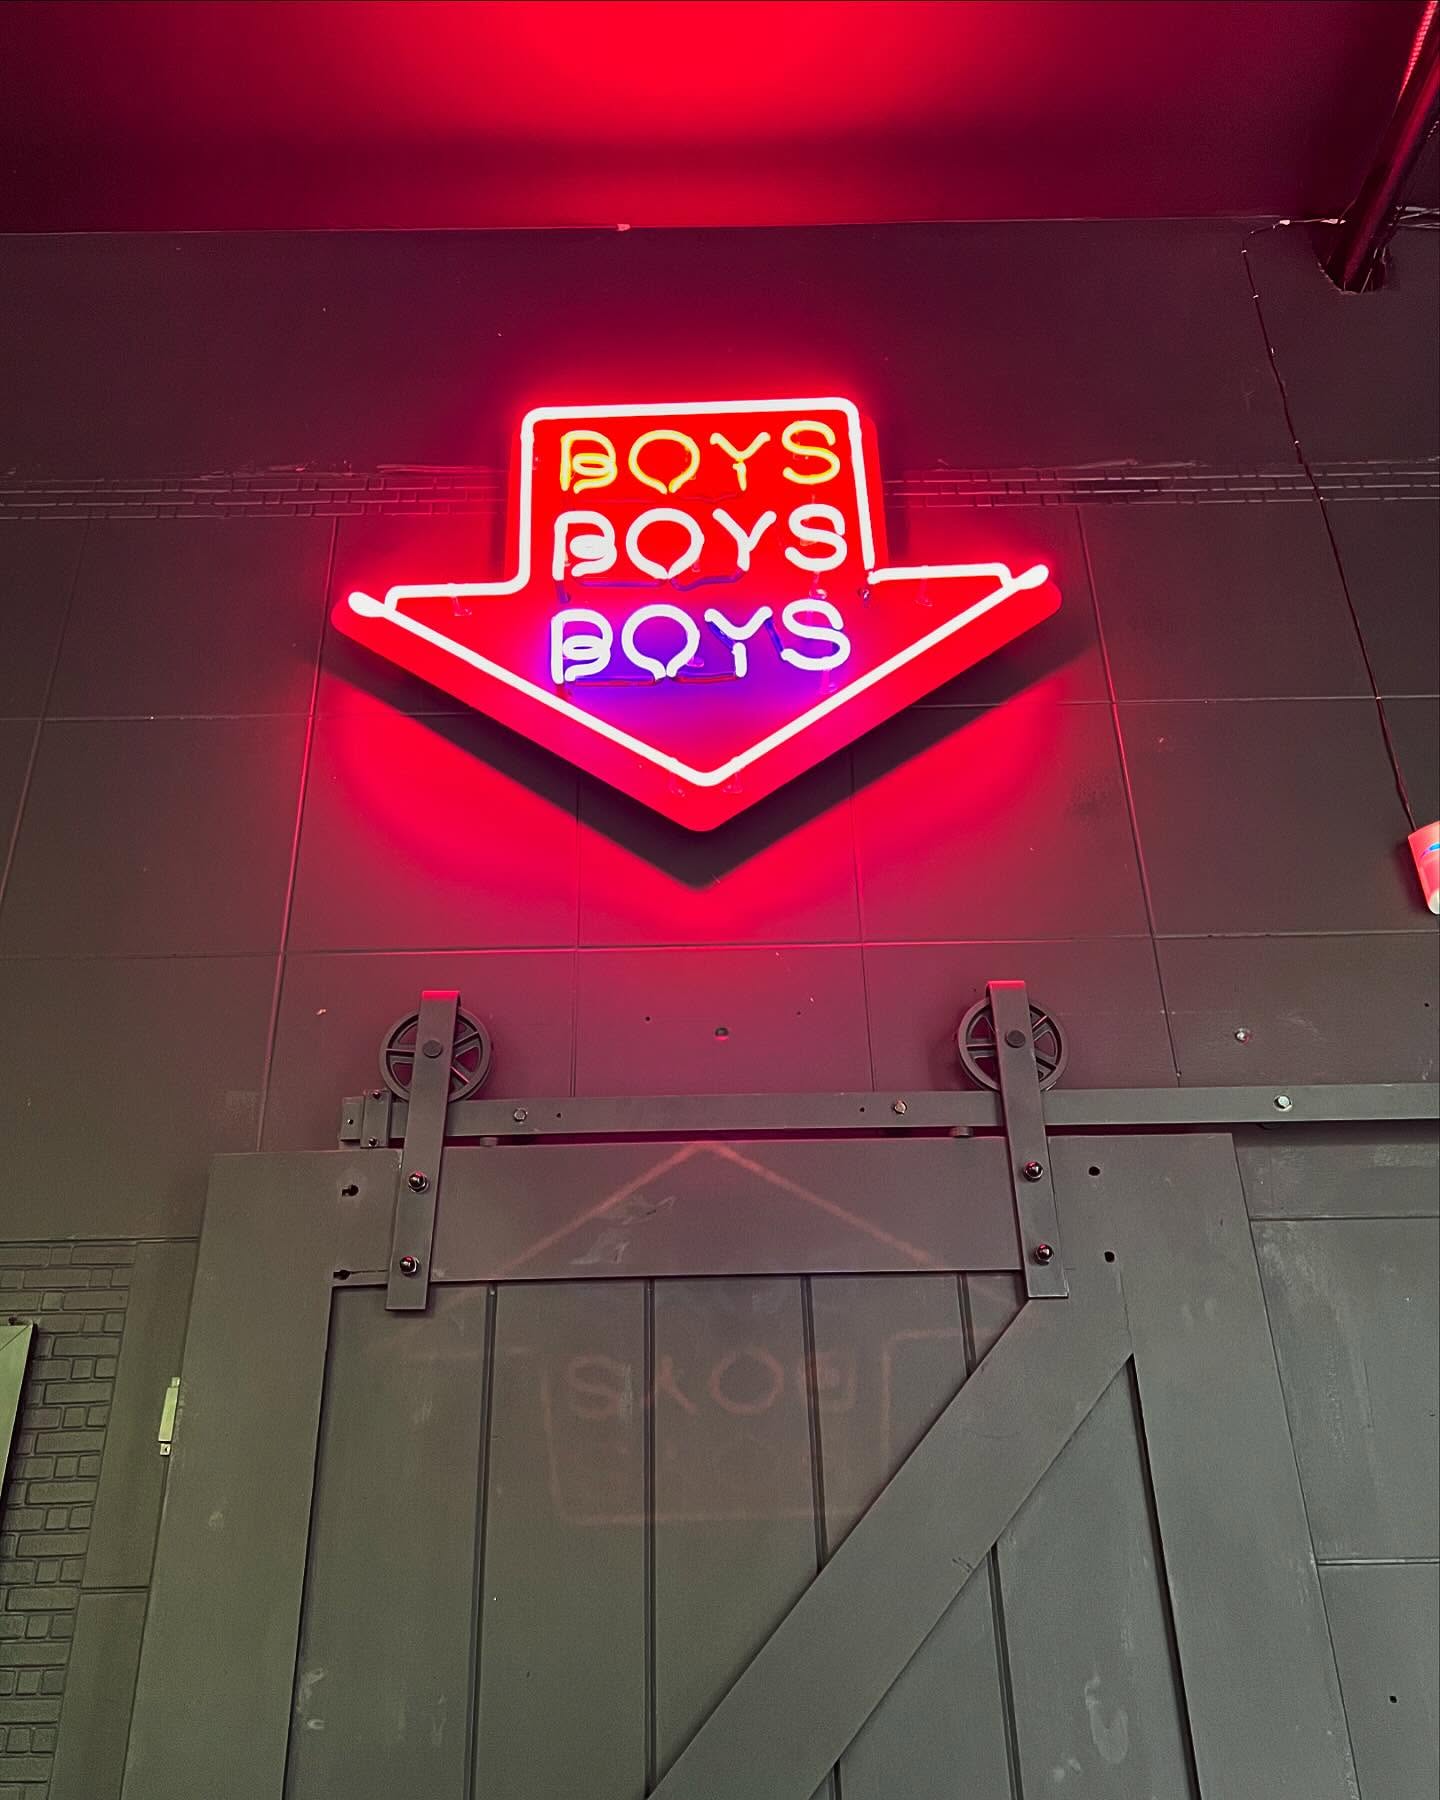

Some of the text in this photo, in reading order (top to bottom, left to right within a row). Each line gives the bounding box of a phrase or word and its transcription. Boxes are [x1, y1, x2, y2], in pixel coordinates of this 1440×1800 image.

[560, 420, 841, 494] BOYS
[553, 503, 848, 581] BOYS
[550, 598, 851, 684] BOYS
